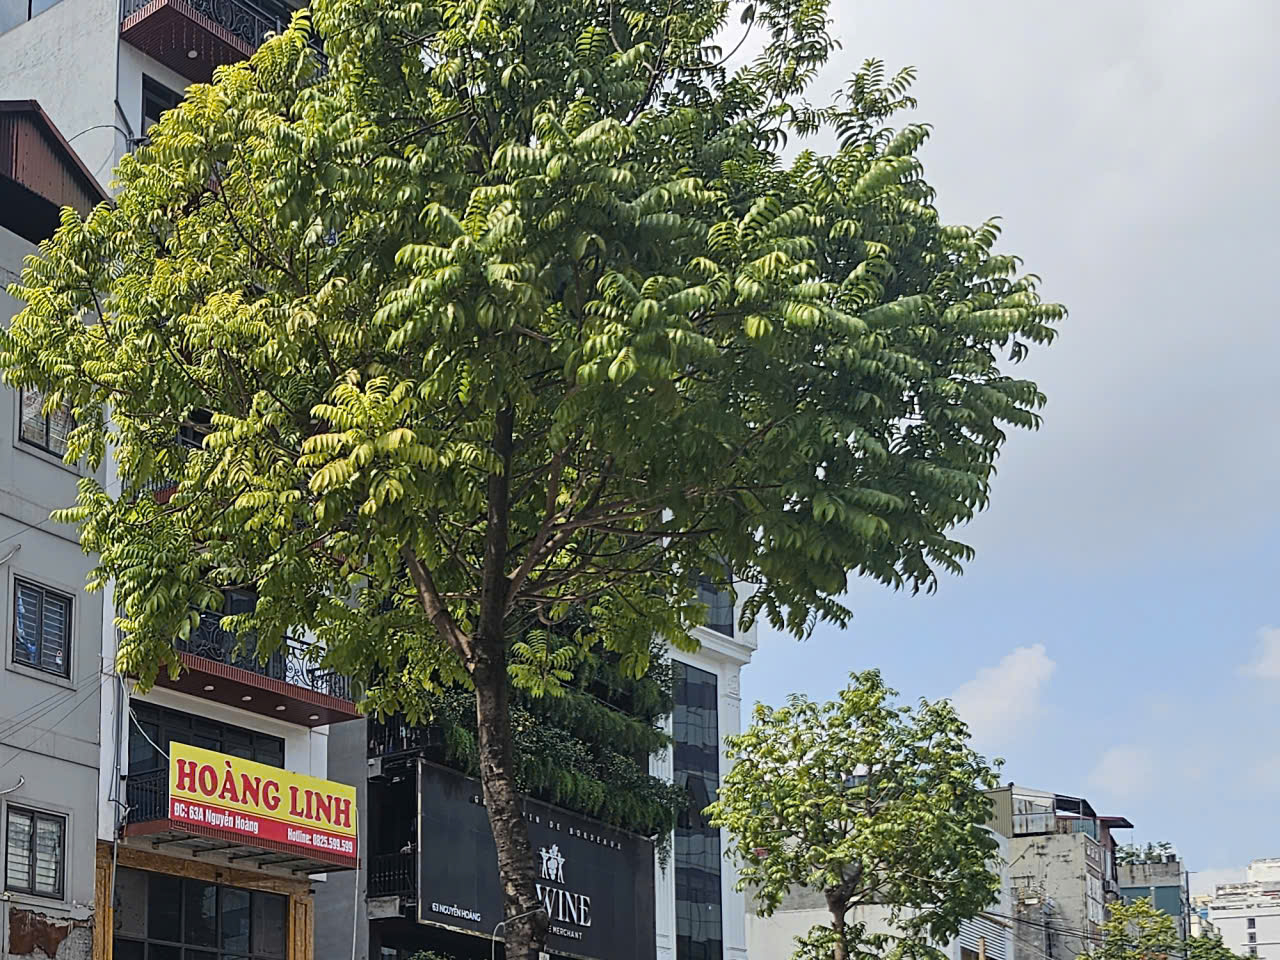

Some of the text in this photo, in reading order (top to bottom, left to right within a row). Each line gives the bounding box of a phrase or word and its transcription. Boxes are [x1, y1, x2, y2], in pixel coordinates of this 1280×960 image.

[176, 758, 352, 829] HOÀNG LINH
[174, 802, 259, 835] ĐC: 63A Nguyễn Hoàng
[287, 827, 312, 845] Hotline:
[552, 926, 583, 940] MERCHANT
